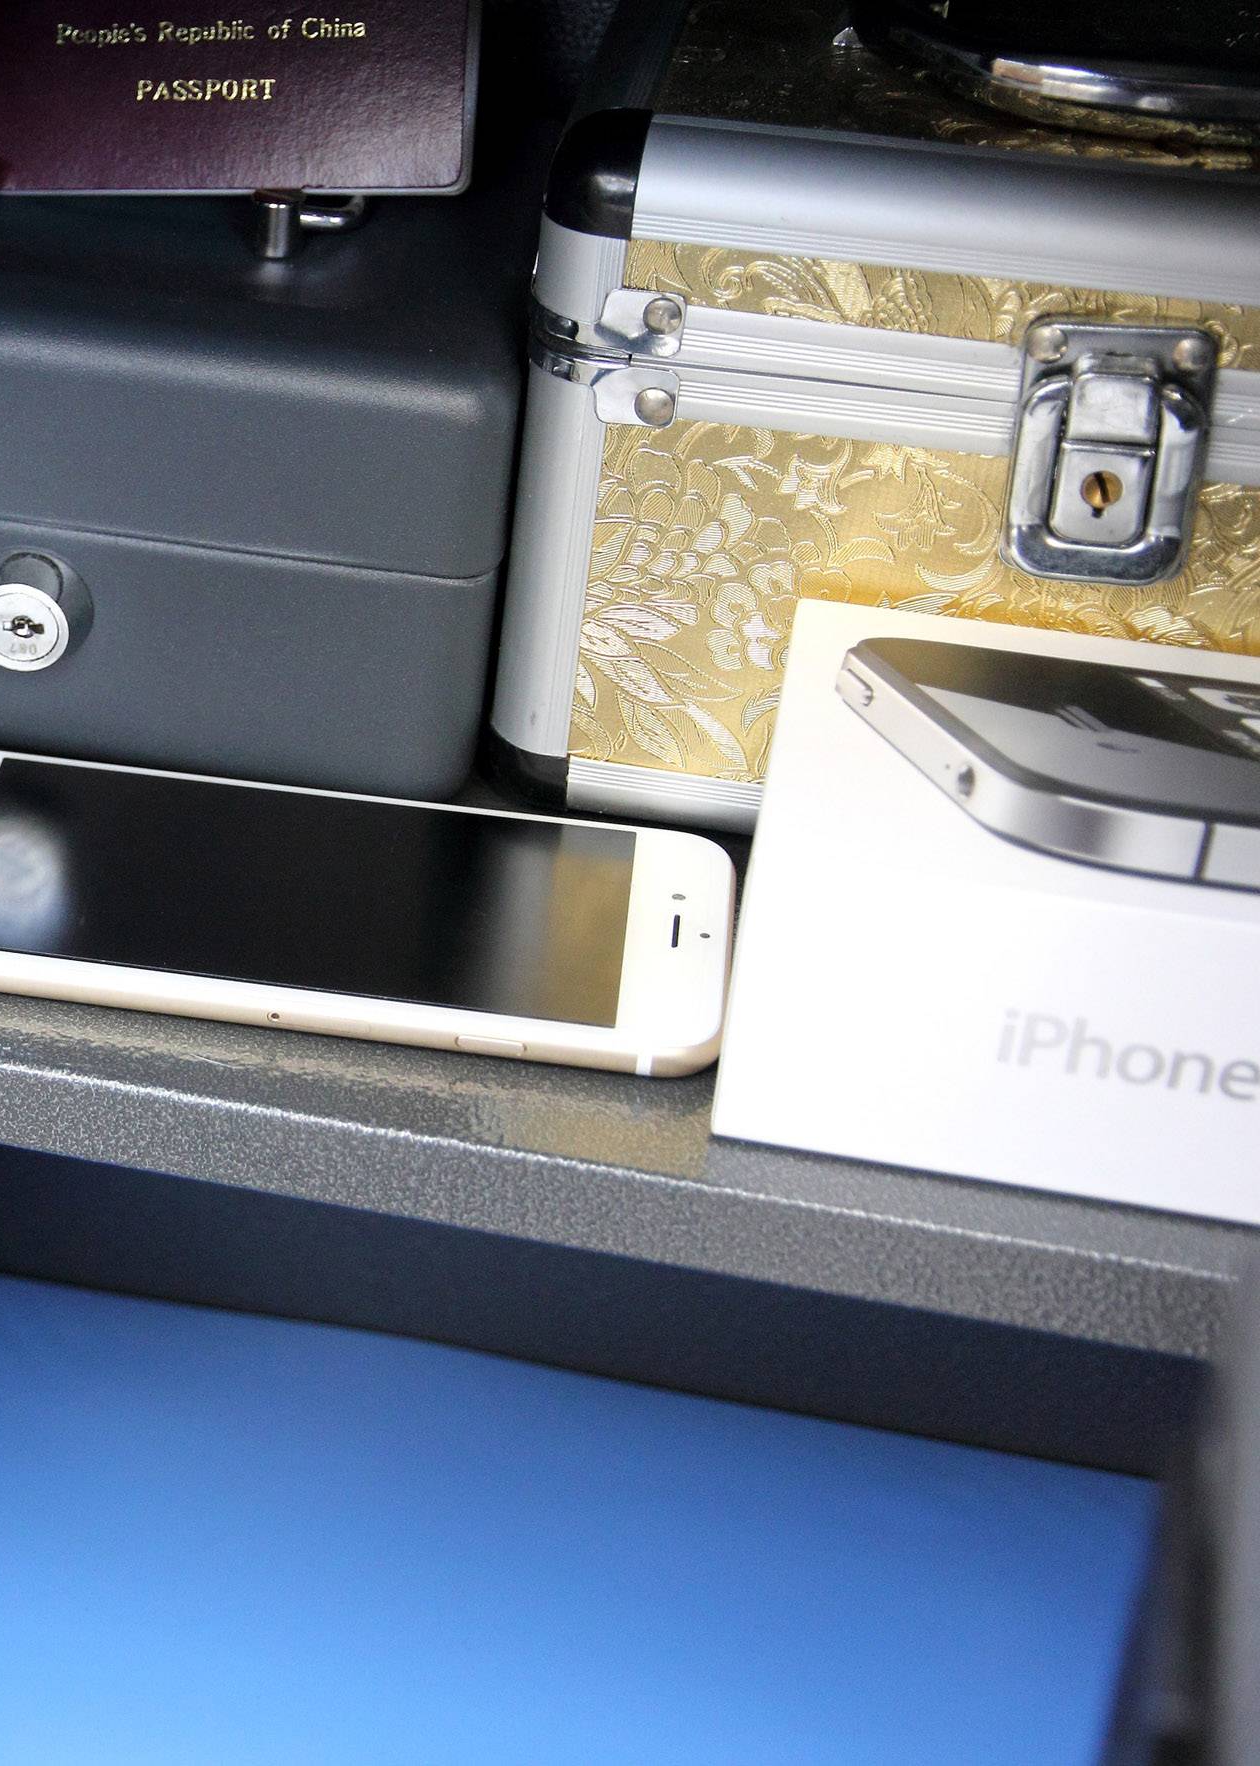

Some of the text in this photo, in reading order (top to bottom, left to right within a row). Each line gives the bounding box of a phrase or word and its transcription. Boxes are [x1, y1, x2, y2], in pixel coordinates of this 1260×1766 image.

[55, 17, 367, 49] People's Republic of China
[135, 78, 277, 101] PASSPORT
[996, 1007, 1260, 1102] iPhone
